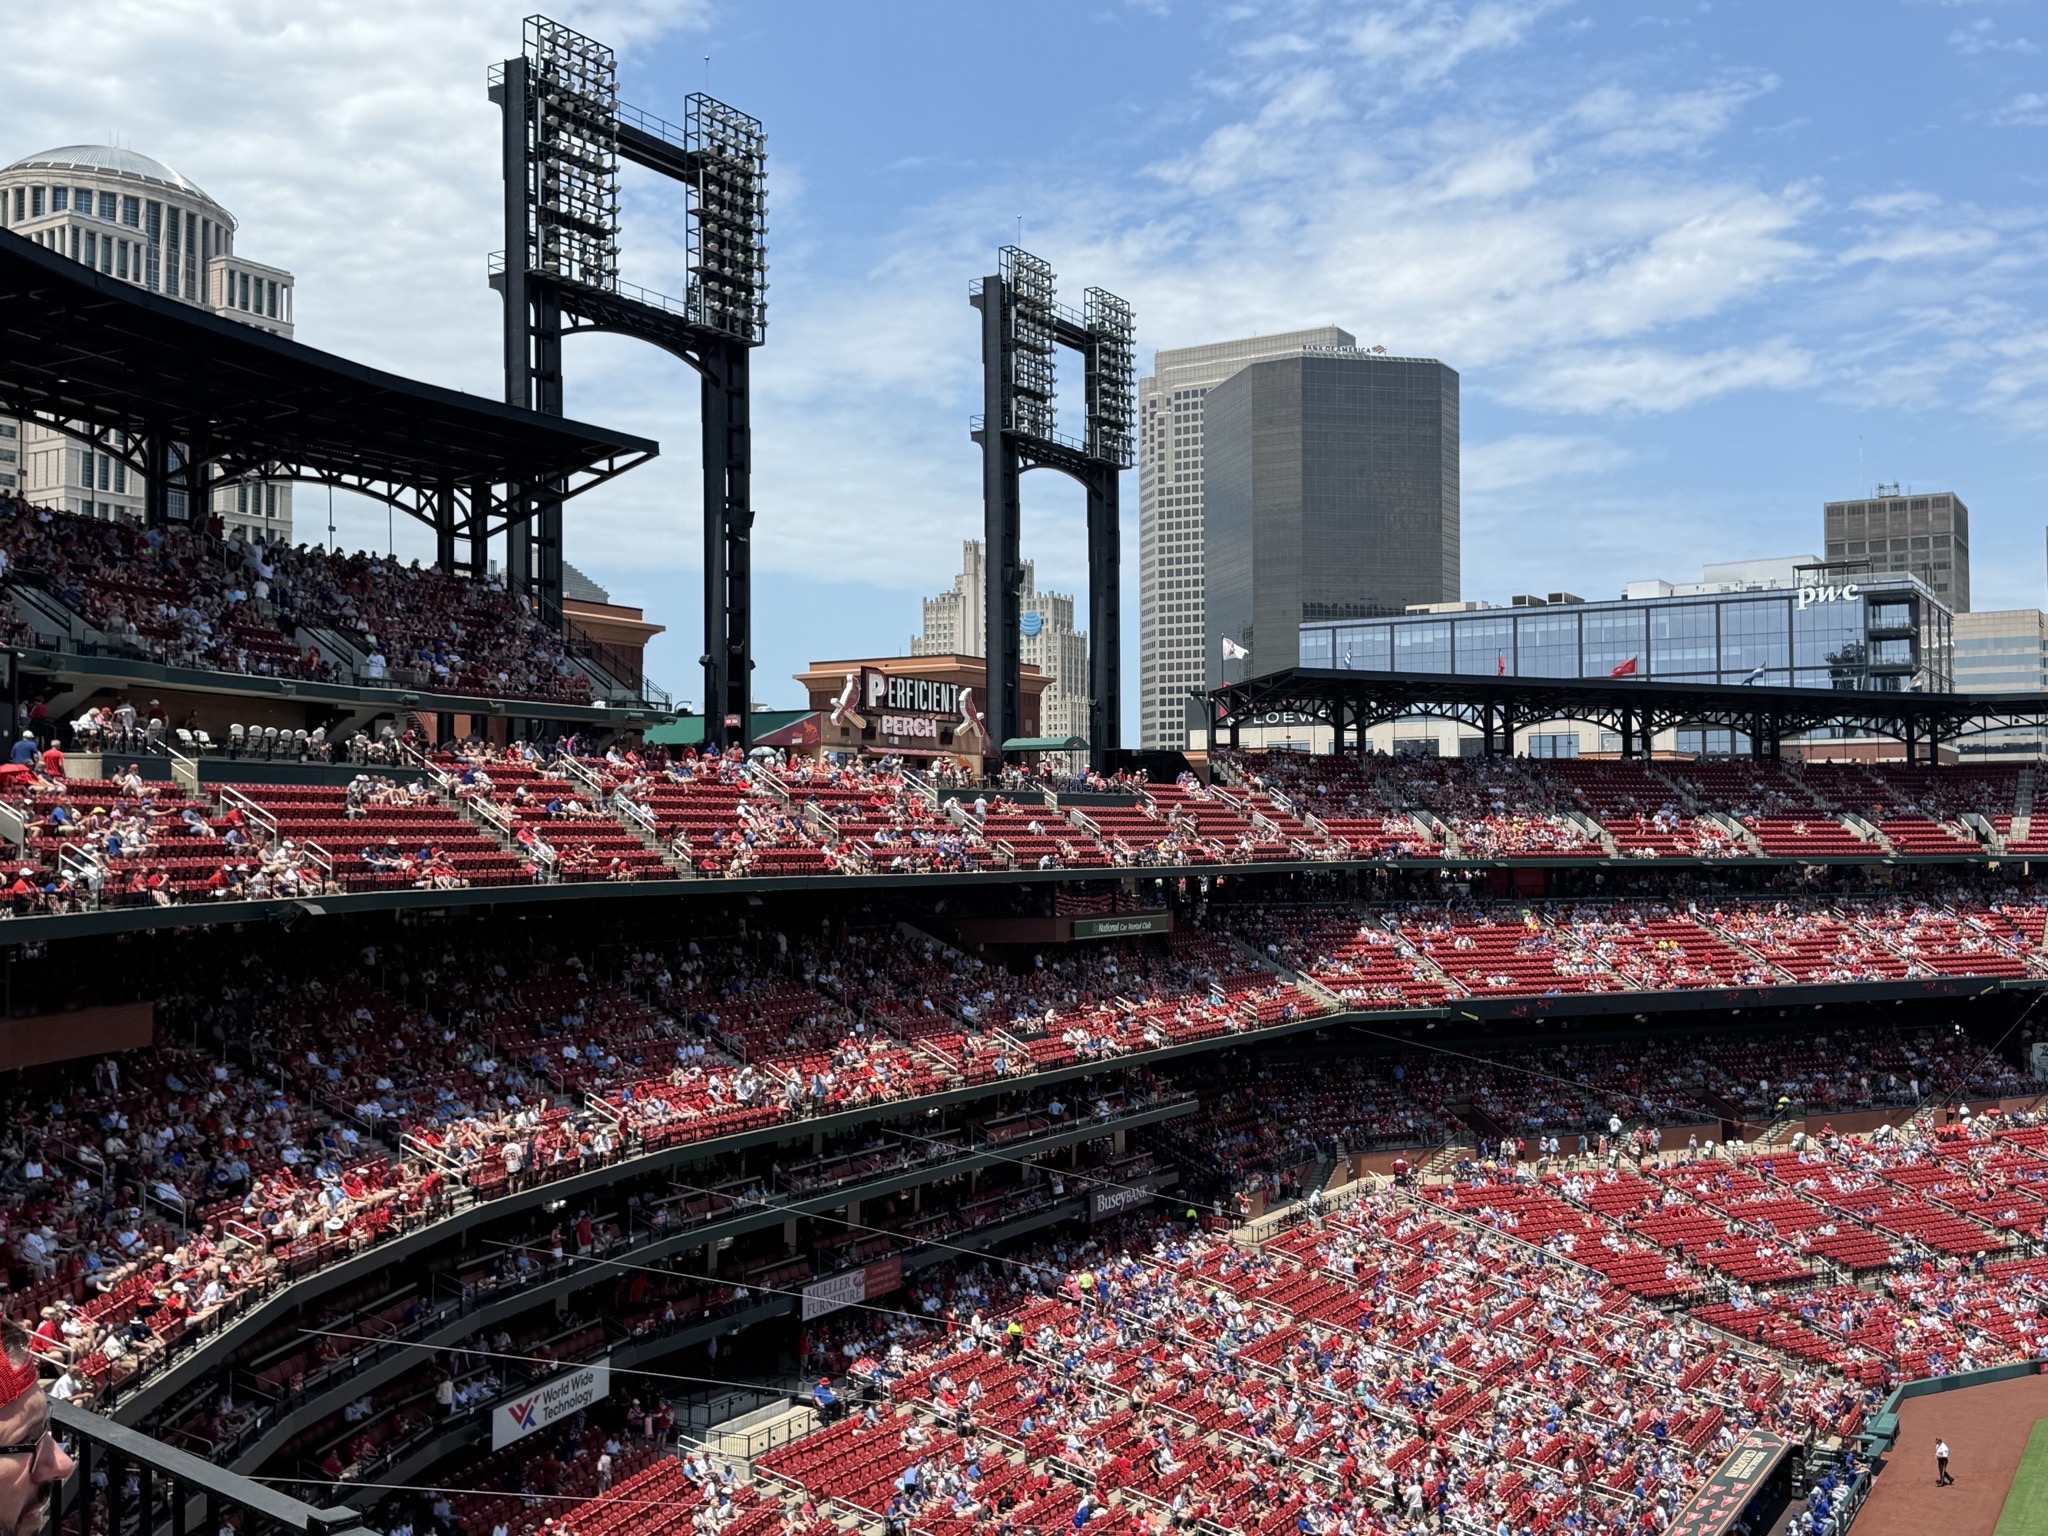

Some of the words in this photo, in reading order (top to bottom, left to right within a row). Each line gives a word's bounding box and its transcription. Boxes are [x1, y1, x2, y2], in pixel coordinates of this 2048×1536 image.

[1302, 344, 1325, 352] BANK
[1336, 345, 1371, 354] AMERICA
[1796, 584, 1859, 611] pwc
[867, 672, 959, 714] PERFICIENT
[881, 715, 937, 738] PERCH
[1098, 922, 1120, 933] National
[1128, 922, 1142, 930] Rental
[1142, 921, 1152, 929] Club
[807, 1275, 851, 1299] MUELLER
[807, 1288, 862, 1316] FURNITURE
[542, 1381, 570, 1405] World
[571, 1371, 594, 1390] Wide
[543, 1388, 594, 1421] Technology
